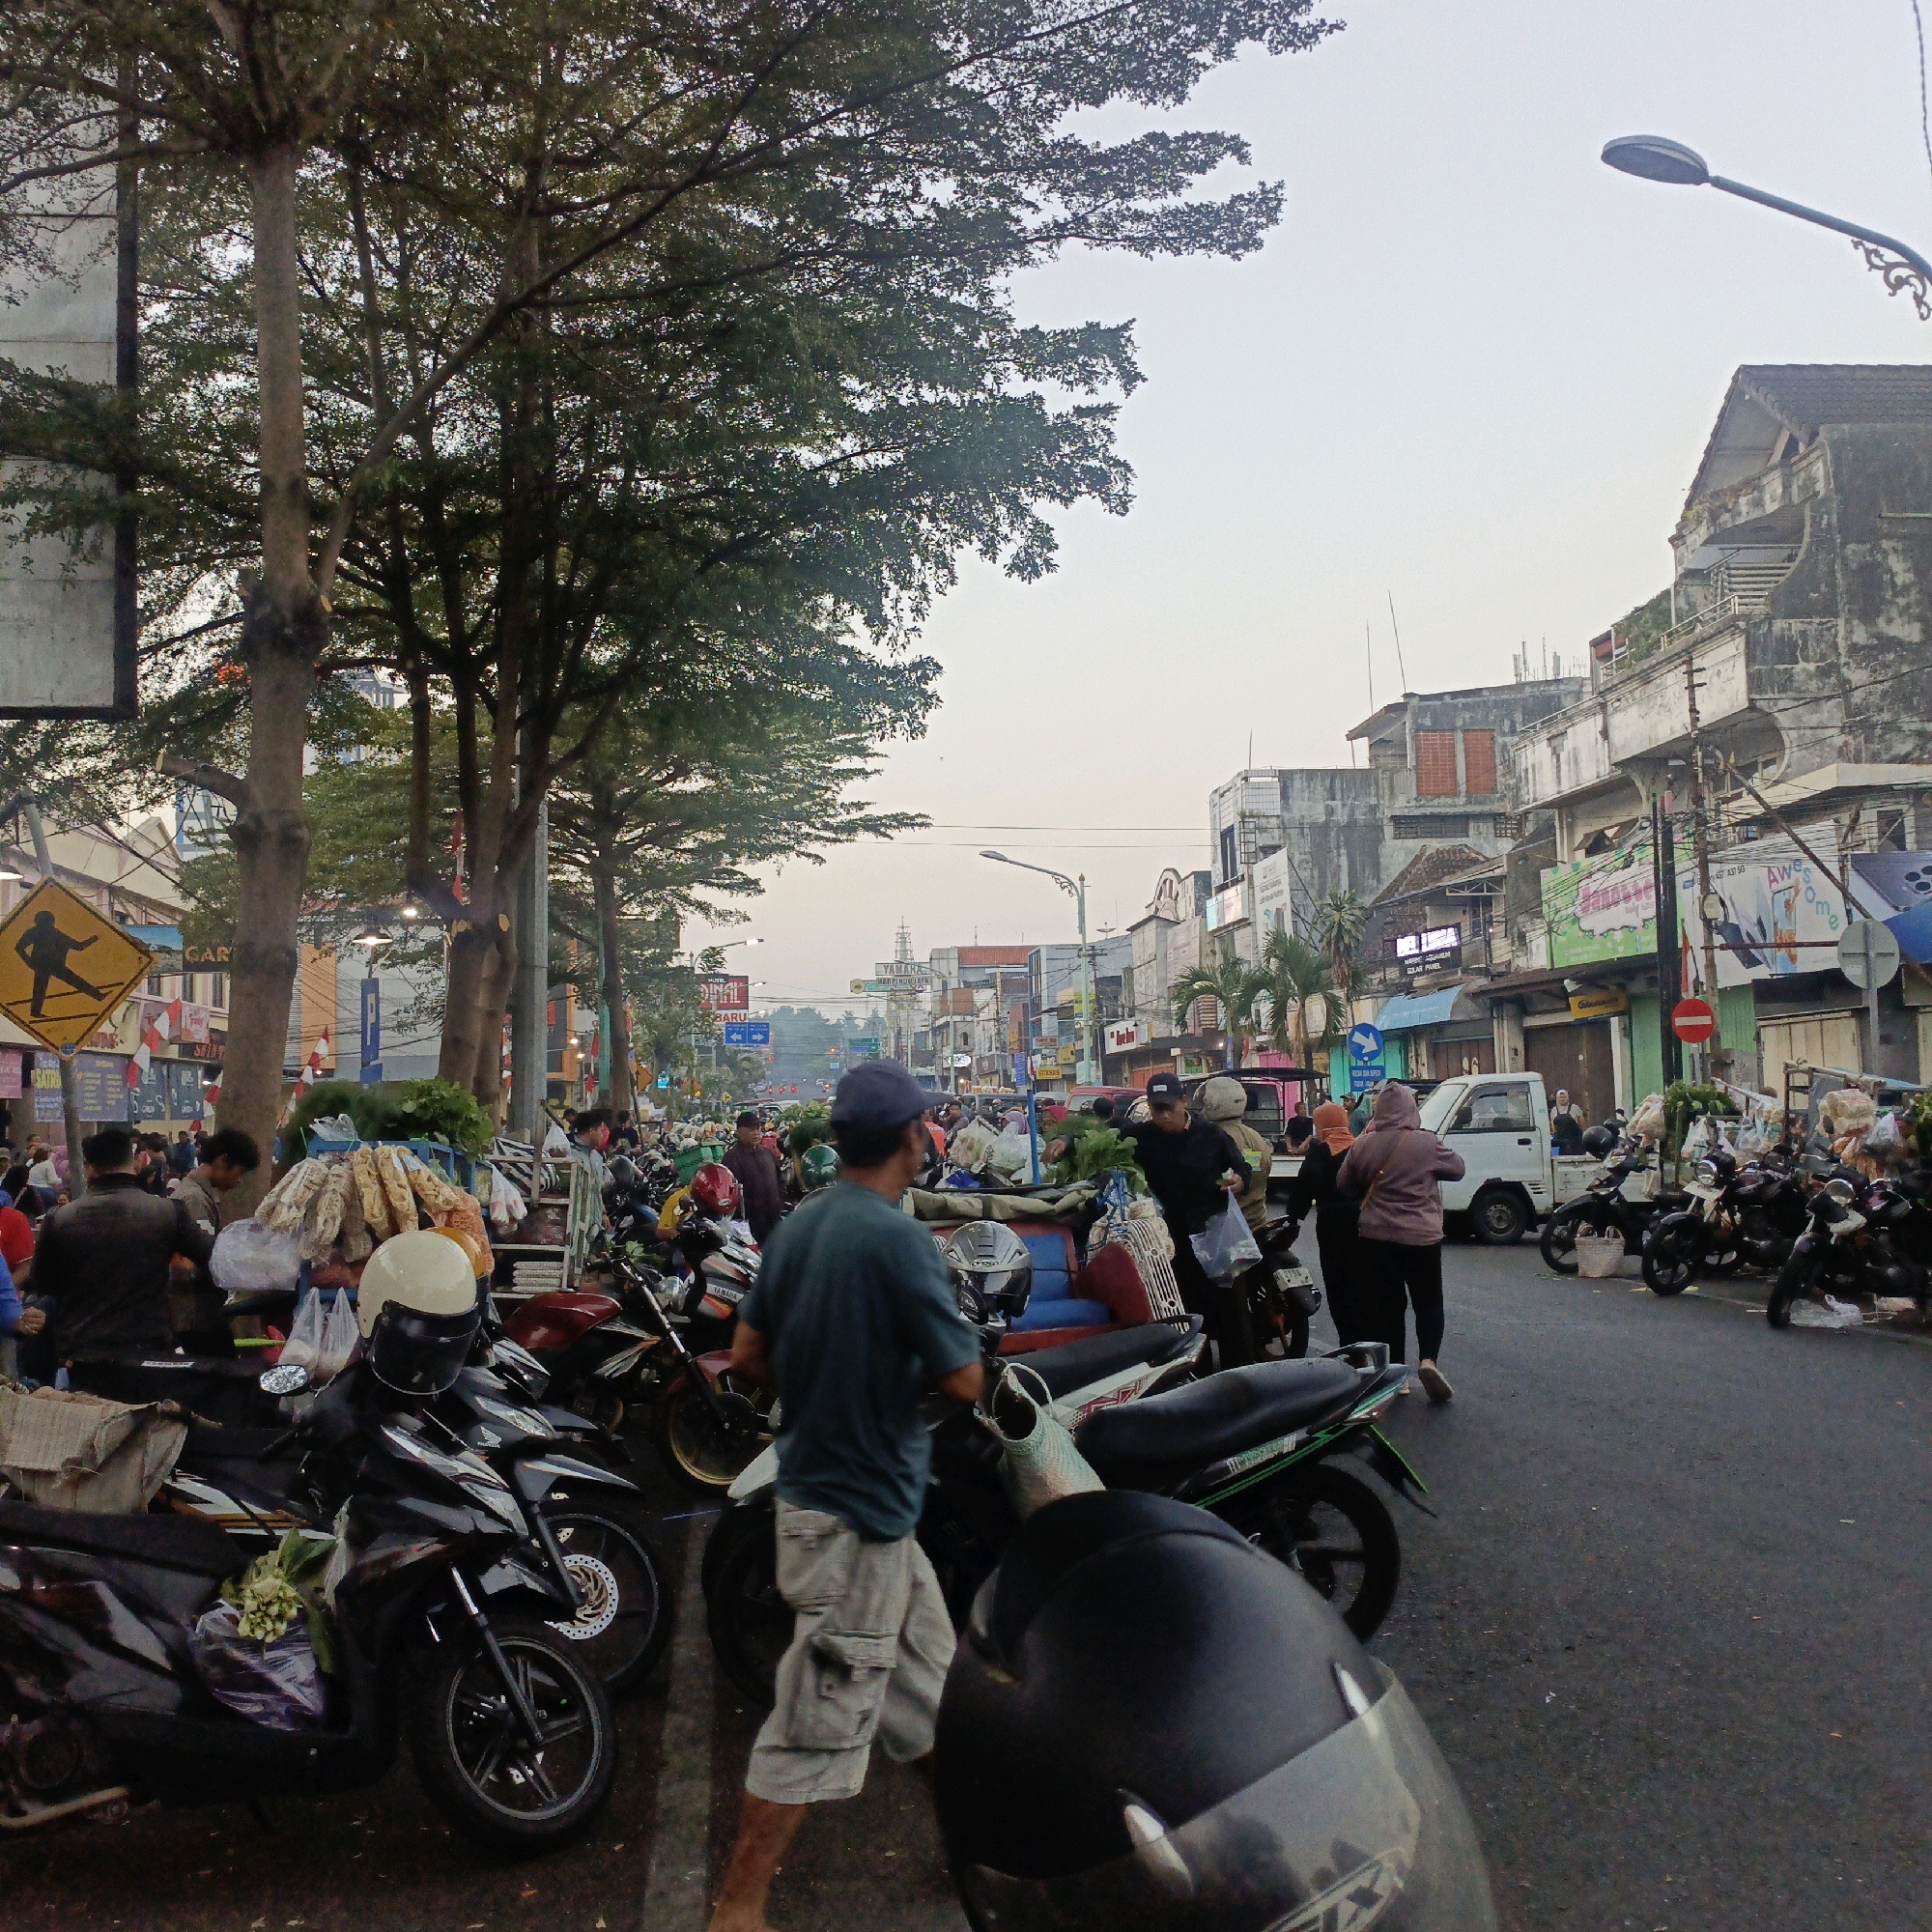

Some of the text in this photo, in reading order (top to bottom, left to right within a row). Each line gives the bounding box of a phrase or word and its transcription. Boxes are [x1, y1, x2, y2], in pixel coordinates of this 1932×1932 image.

[883, 964, 923, 975] YAMAHA
[1406, 962, 1441, 975] SOLAR PANEL
[714, 1286, 738, 1300] YAMAHA
